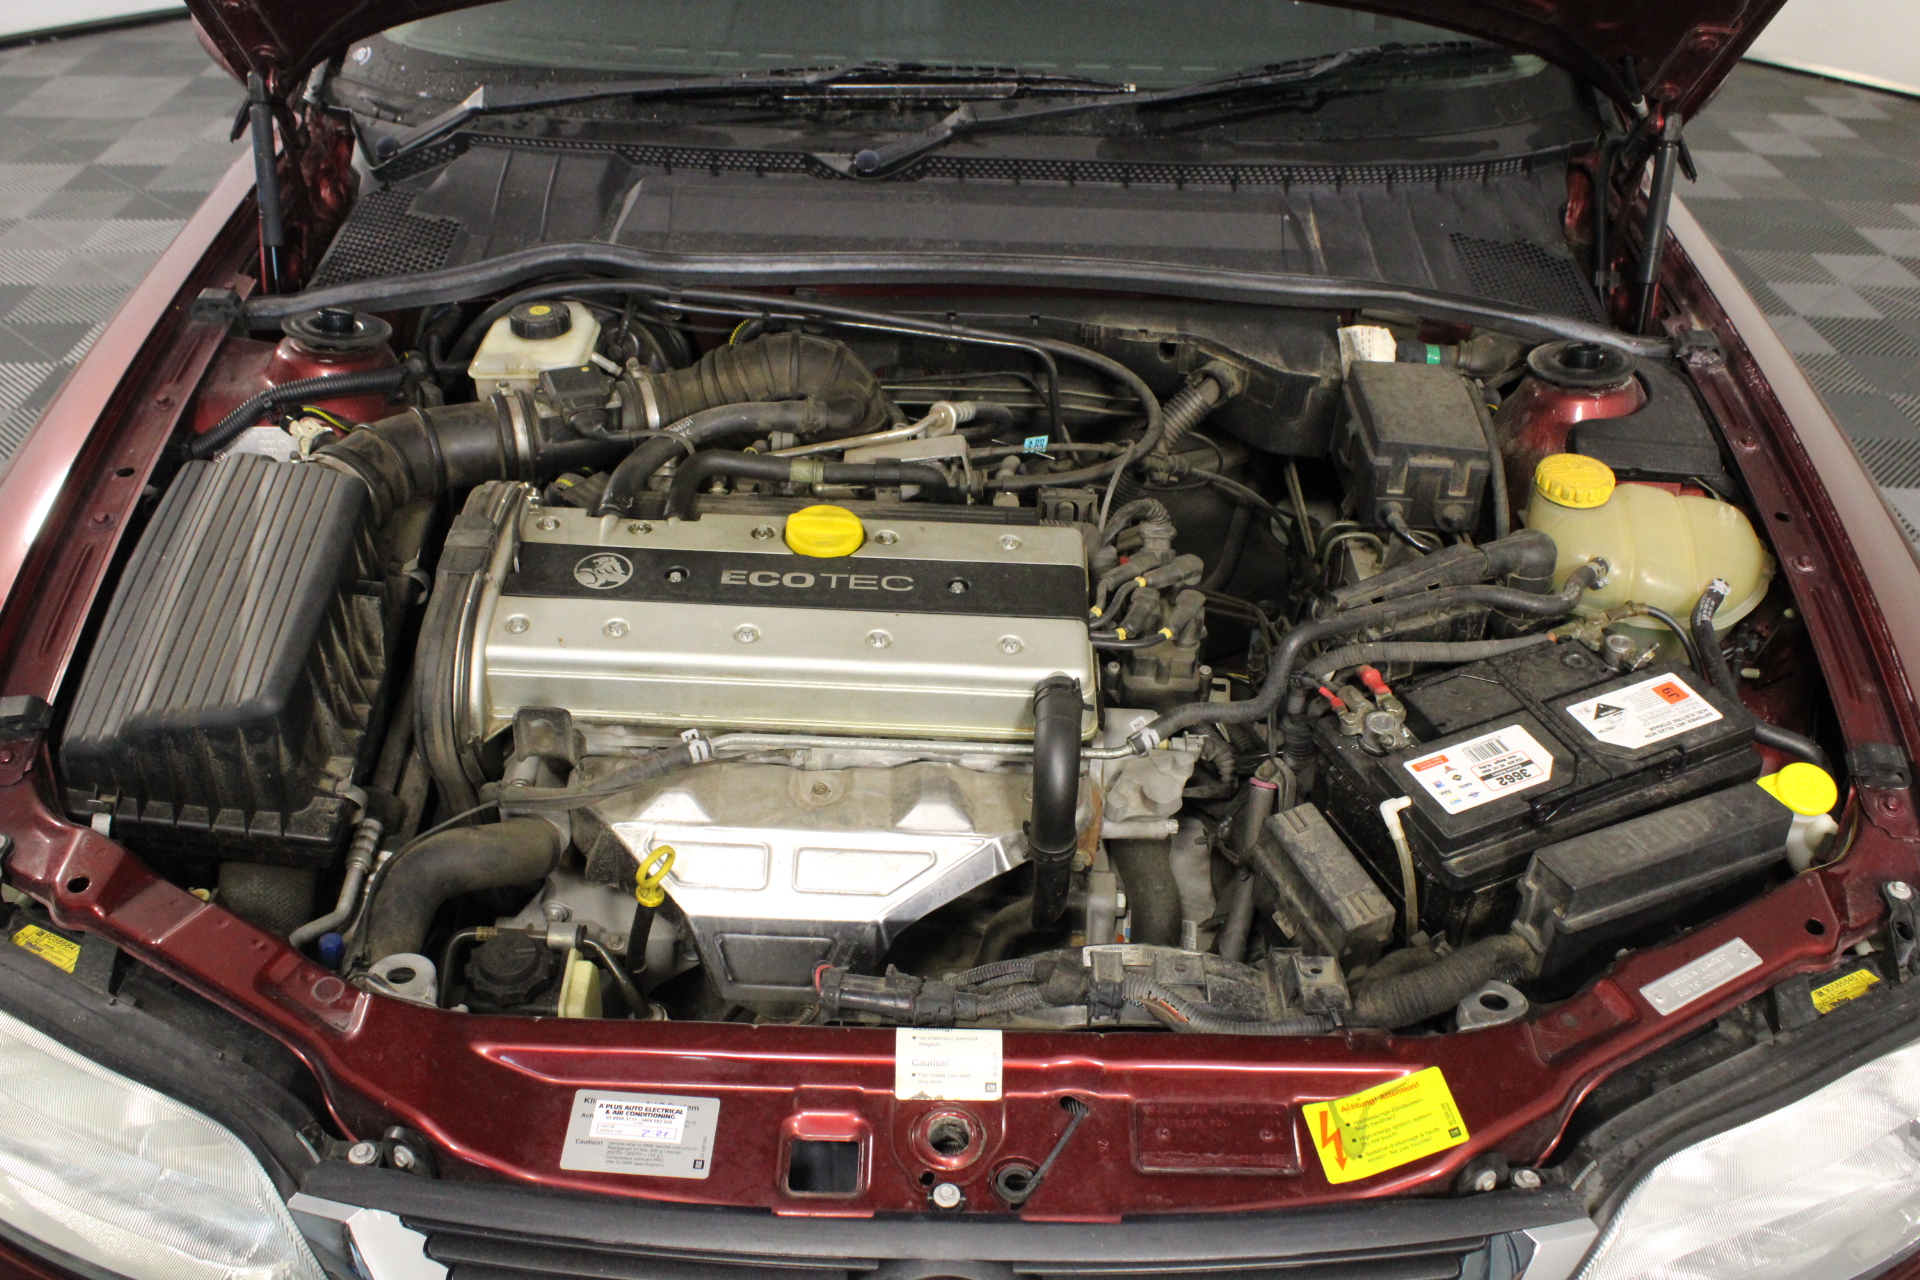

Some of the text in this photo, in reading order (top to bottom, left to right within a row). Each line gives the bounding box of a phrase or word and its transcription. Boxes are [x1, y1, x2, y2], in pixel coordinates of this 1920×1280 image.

[720, 570, 914, 592] ECOTEC
[1494, 767, 1532, 787] 3662
[912, 1059, 950, 1067] Caution!
[1339, 1081, 1420, 1114] Achtung! Attention!
[626, 1111, 675, 1119] CONDITIONING
[645, 1106, 684, 1114] ELECTRICAL
